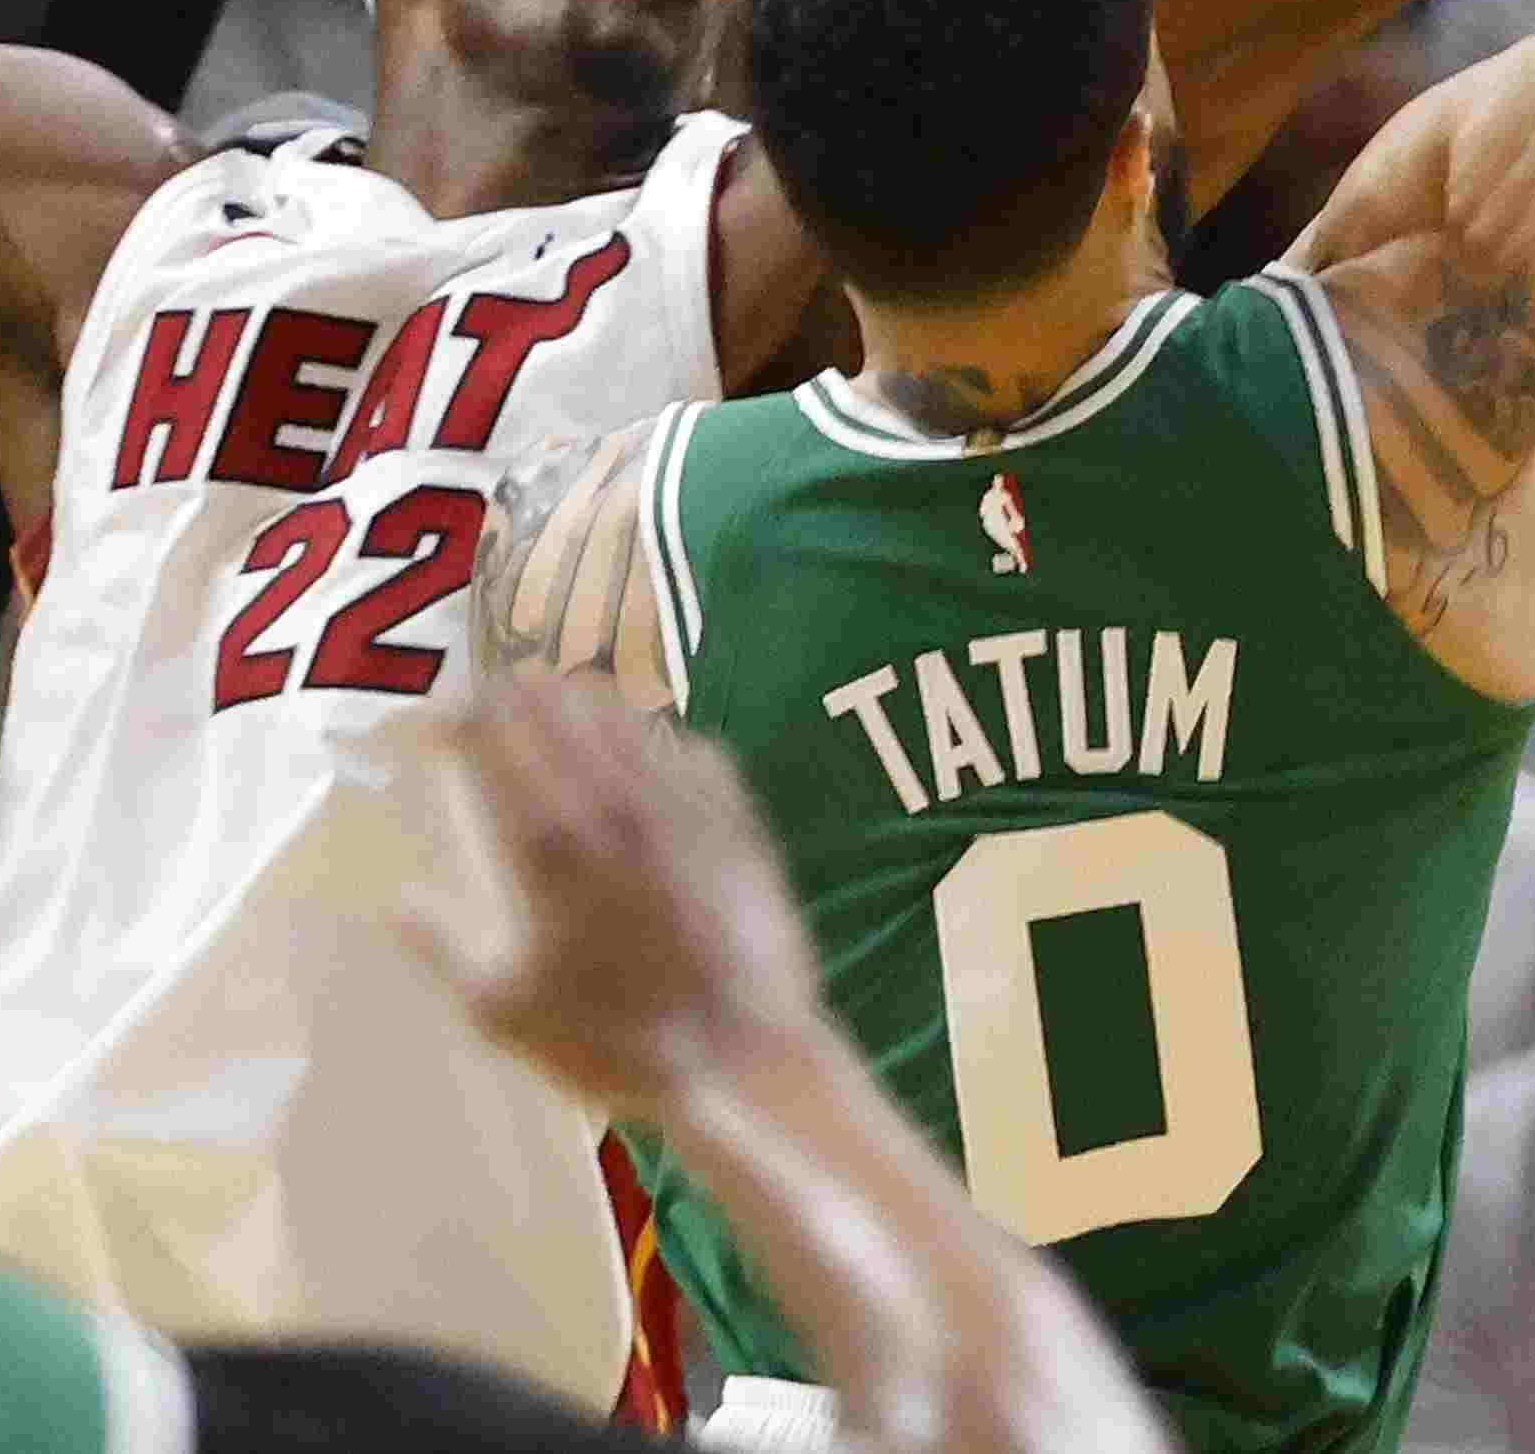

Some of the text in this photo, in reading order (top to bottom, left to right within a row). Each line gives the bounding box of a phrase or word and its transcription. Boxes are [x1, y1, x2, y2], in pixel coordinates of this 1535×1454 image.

[111, 230, 630, 493] HEAT
[213, 484, 487, 715] 22
[822, 626, 1238, 815] TATUM
[932, 809, 1264, 1246] 0
